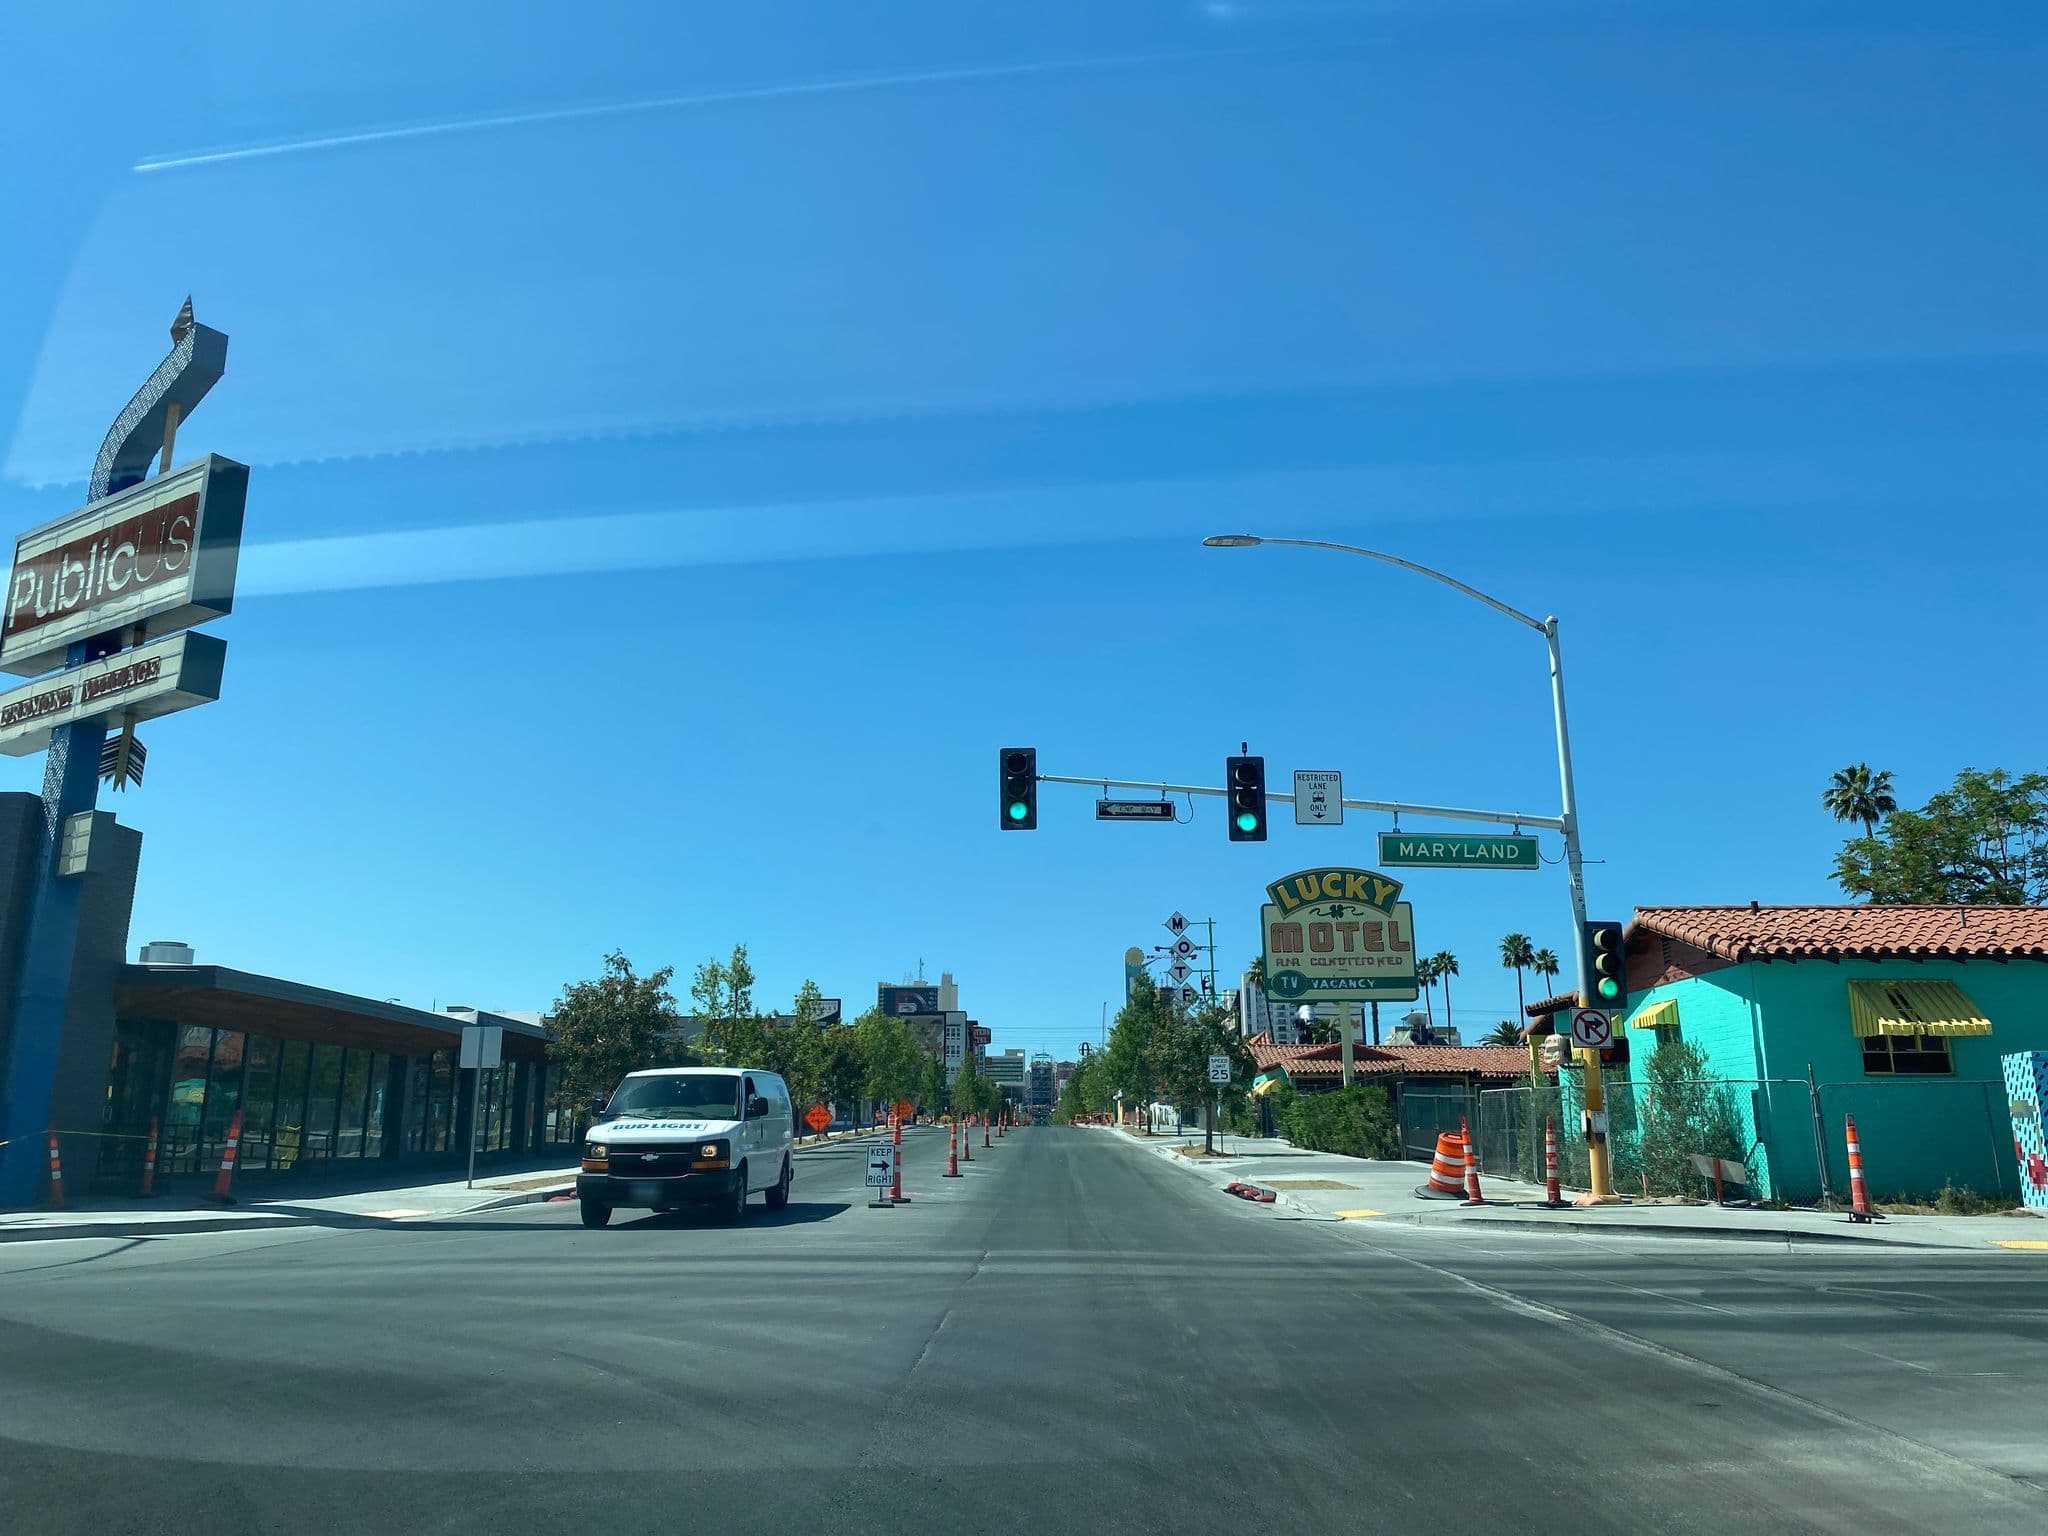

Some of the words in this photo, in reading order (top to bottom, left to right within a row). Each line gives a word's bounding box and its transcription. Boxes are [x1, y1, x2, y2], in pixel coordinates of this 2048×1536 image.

[1400, 842, 1519, 859] MARYLAND
[1277, 873, 1395, 909] LUCKY
[1270, 921, 1410, 953] MOTEL
[1281, 976, 1298, 989] TV
[1311, 979, 1376, 989] VACANCY
[1211, 1069, 1229, 1080] 25
[612, 1123, 650, 1131] BUD
[651, 1122, 703, 1130] LIGHT
[870, 1148, 892, 1157] KEEP
[867, 1174, 892, 1184] RIGHT
